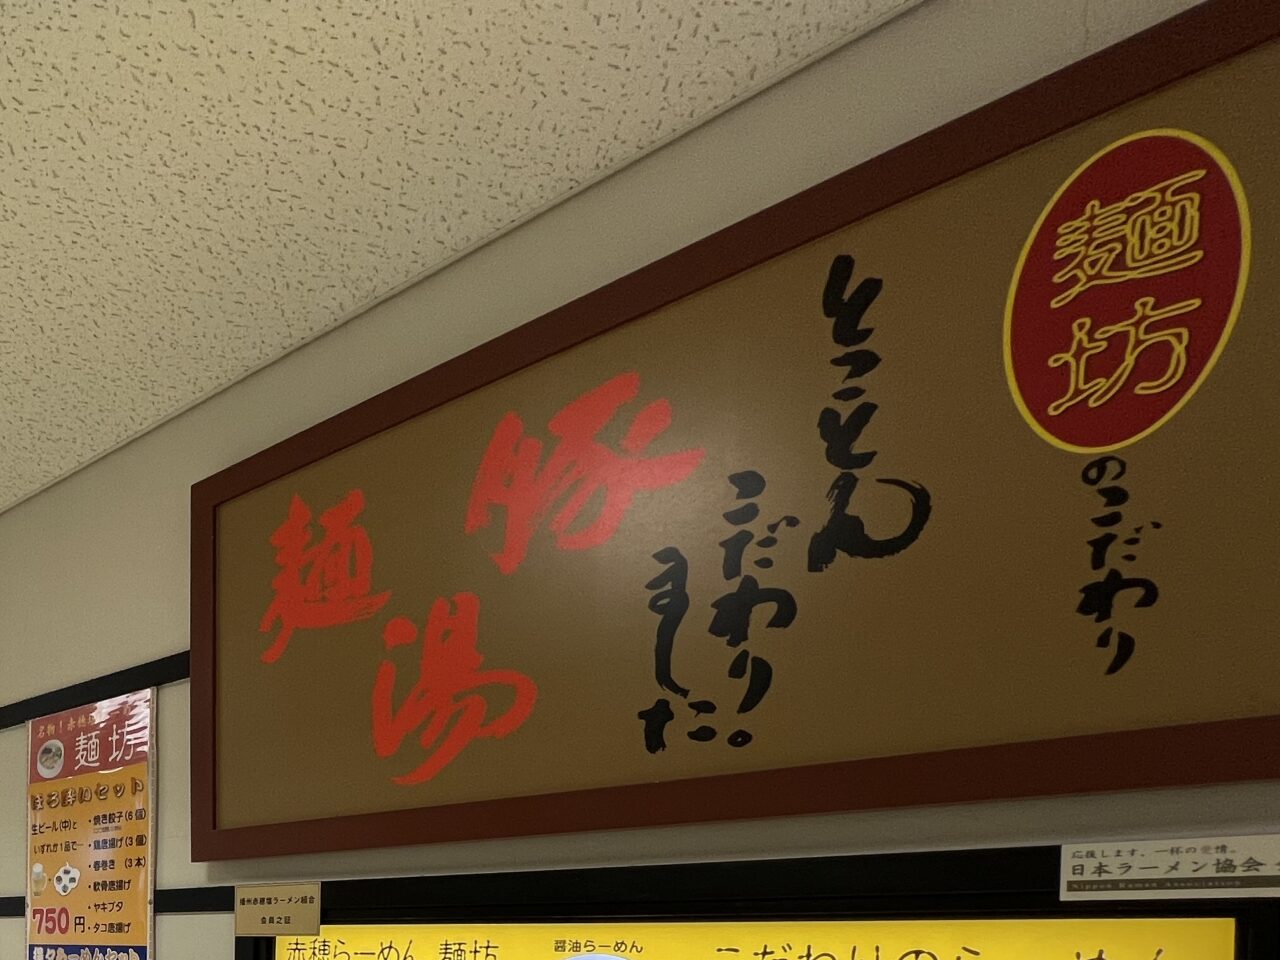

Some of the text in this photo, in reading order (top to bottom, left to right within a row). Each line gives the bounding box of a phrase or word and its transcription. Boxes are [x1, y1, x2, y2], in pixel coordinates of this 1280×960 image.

[1048, 168, 1208, 416] 麺坊
[807, 253, 932, 572] とことん
[707, 470, 799, 715] こだわり
[1075, 455, 1161, 675] のこだわり
[74, 721, 136, 771] 麺坊
[553, 939, 644, 954] 醤油らーめん
